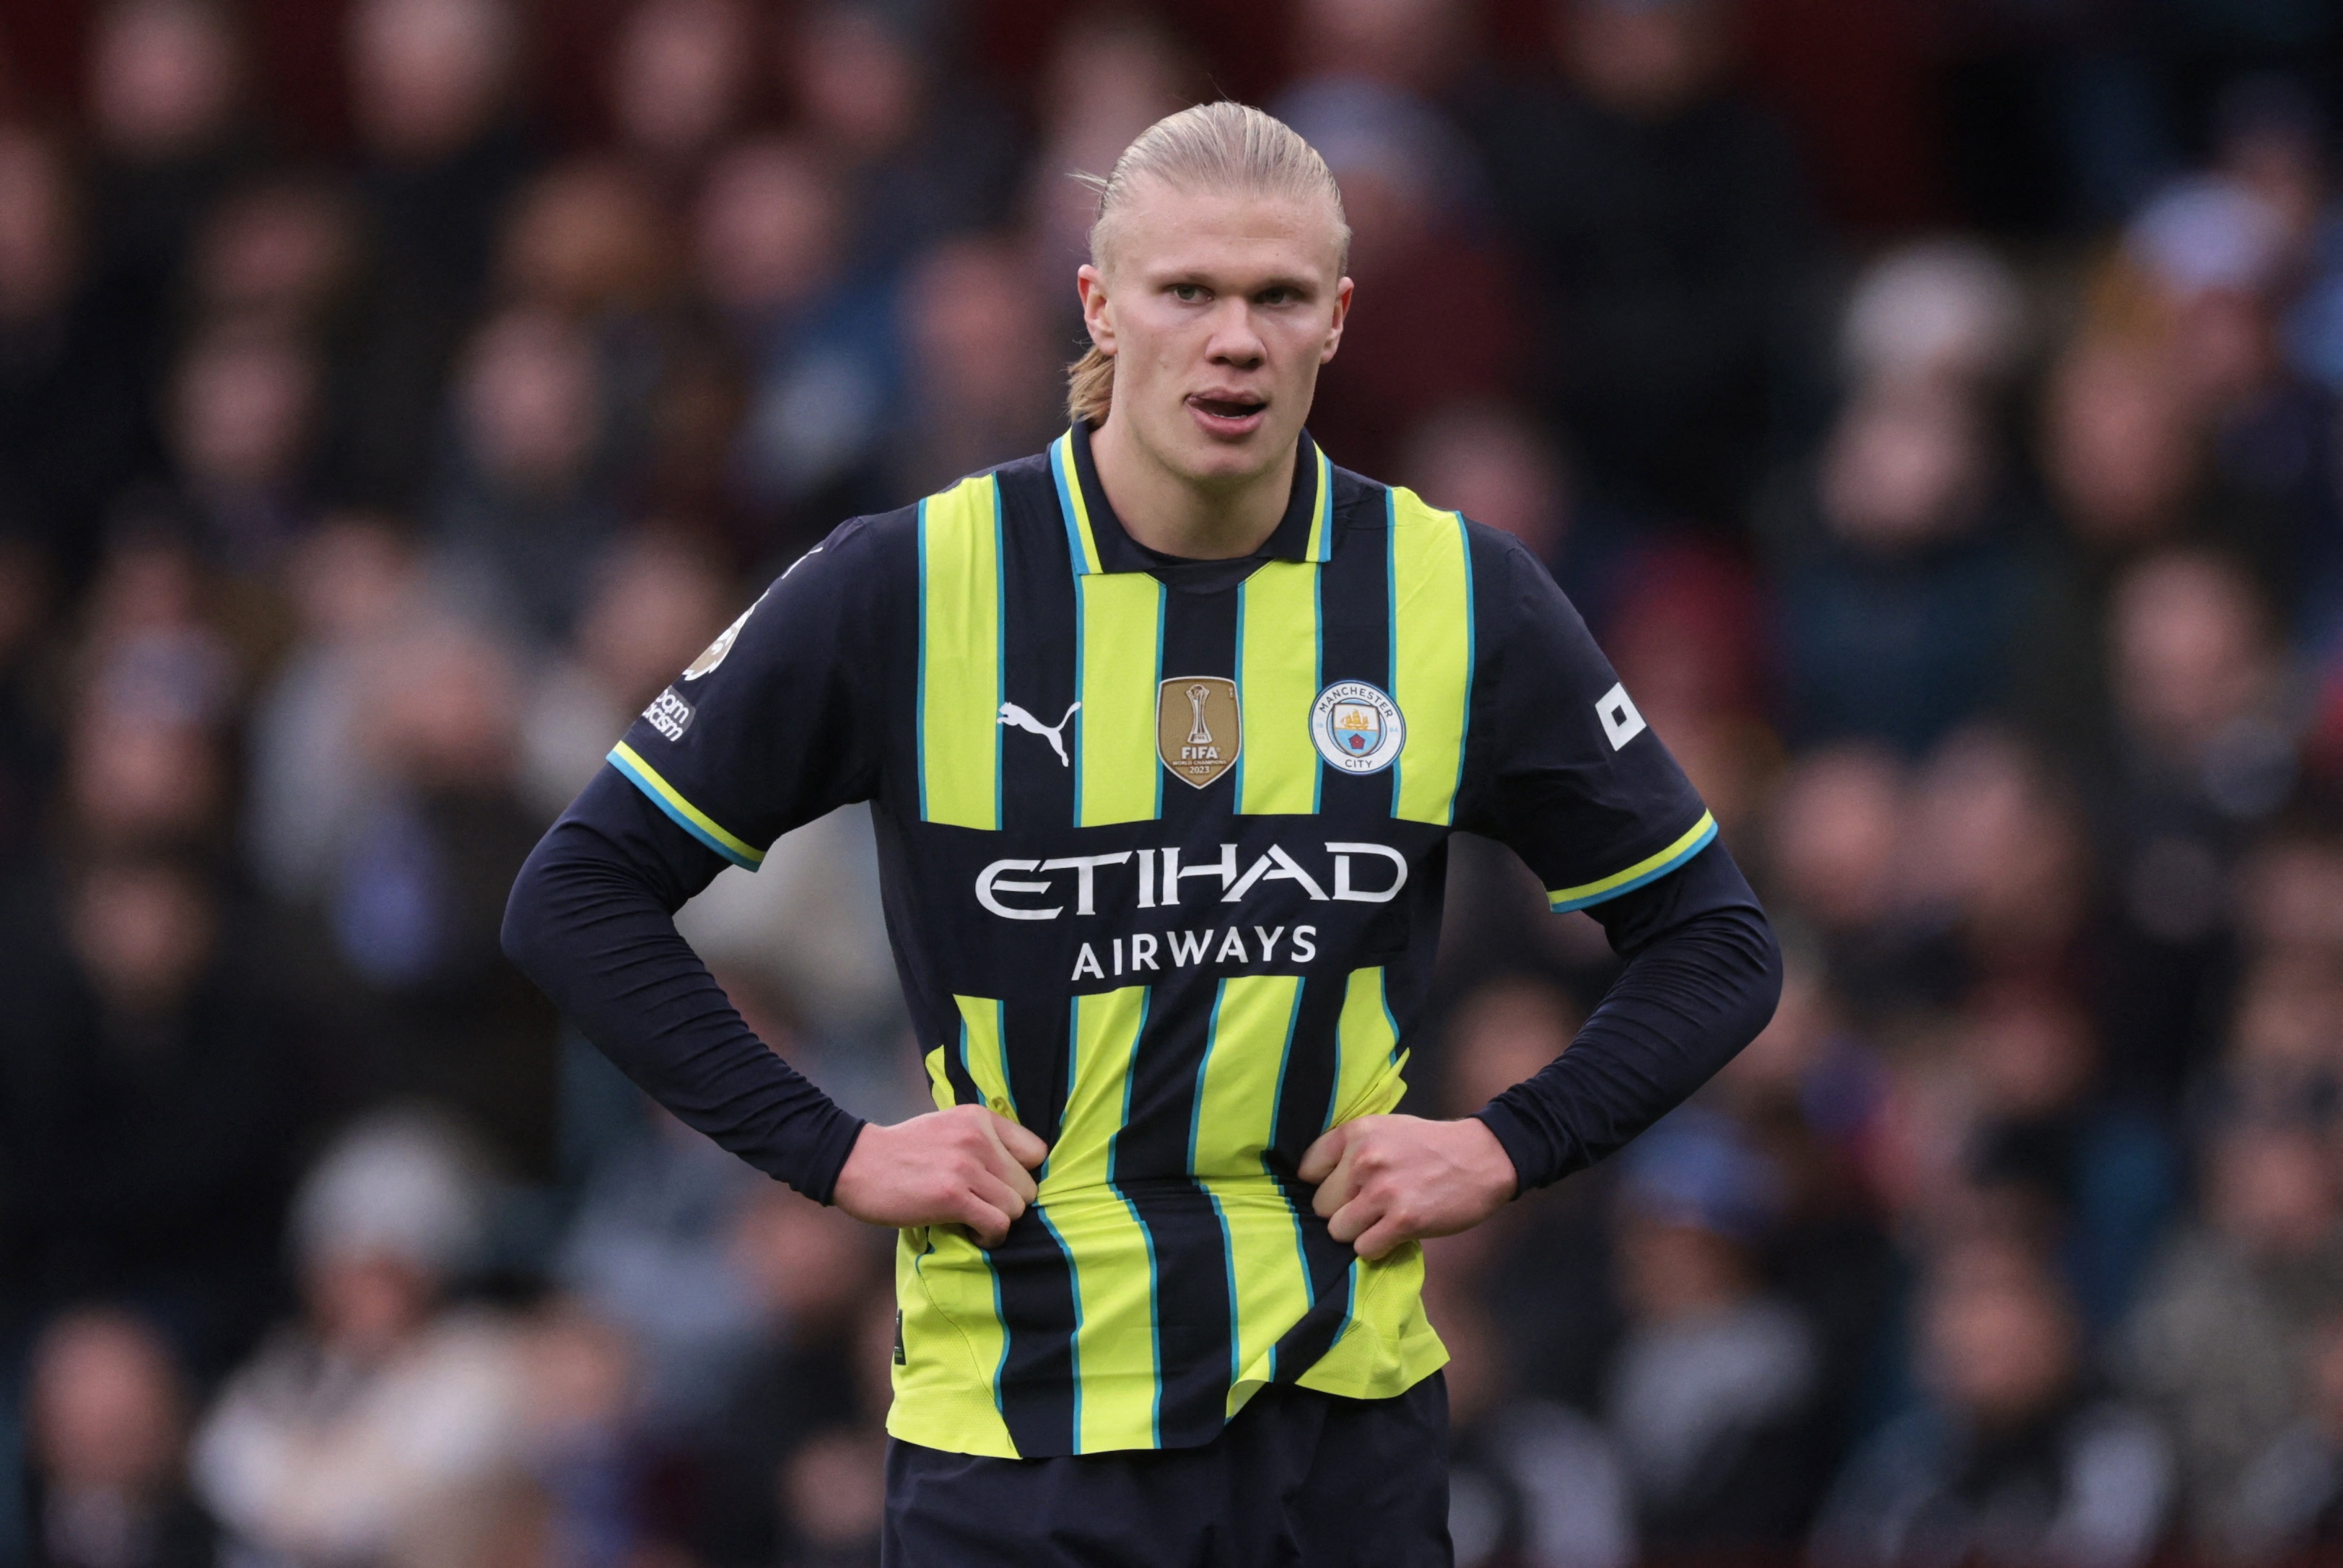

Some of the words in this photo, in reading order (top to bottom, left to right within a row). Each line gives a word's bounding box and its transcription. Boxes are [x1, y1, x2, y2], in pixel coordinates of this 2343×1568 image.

[1319, 687, 1393, 718] MANCHESTER
[1182, 746, 1218, 759] FIFA
[1345, 759, 1372, 768] CITY
[975, 842, 1408, 920] ETIHAD
[1071, 925, 1317, 981] AIRWAYS
